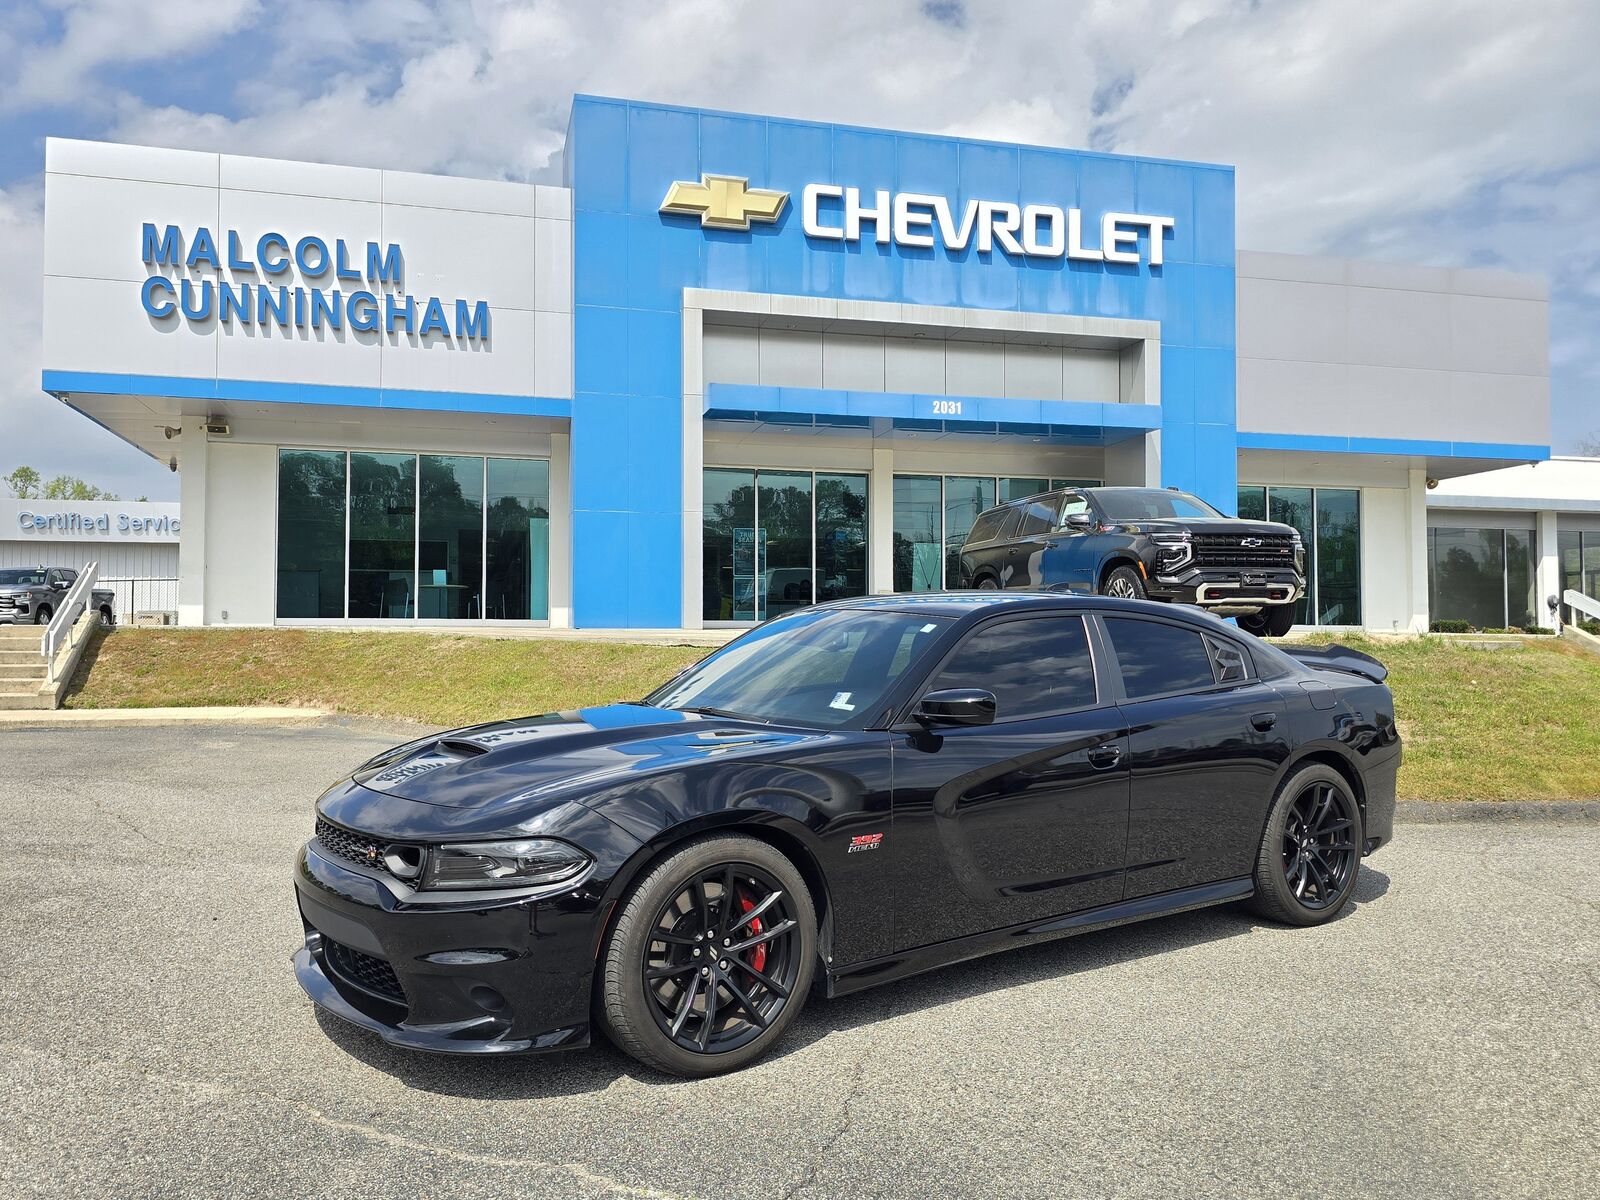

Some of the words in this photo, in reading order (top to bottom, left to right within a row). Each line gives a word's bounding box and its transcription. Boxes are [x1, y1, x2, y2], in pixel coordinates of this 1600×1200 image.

[803, 183, 1174, 266] CHEVROLET
[142, 223, 402, 284] MALCOLM
[141, 275, 489, 340] CUNNINGHAM
[933, 400, 962, 414] 2031
[18, 511, 109, 531] Certified
[850, 832, 883, 846] 392
